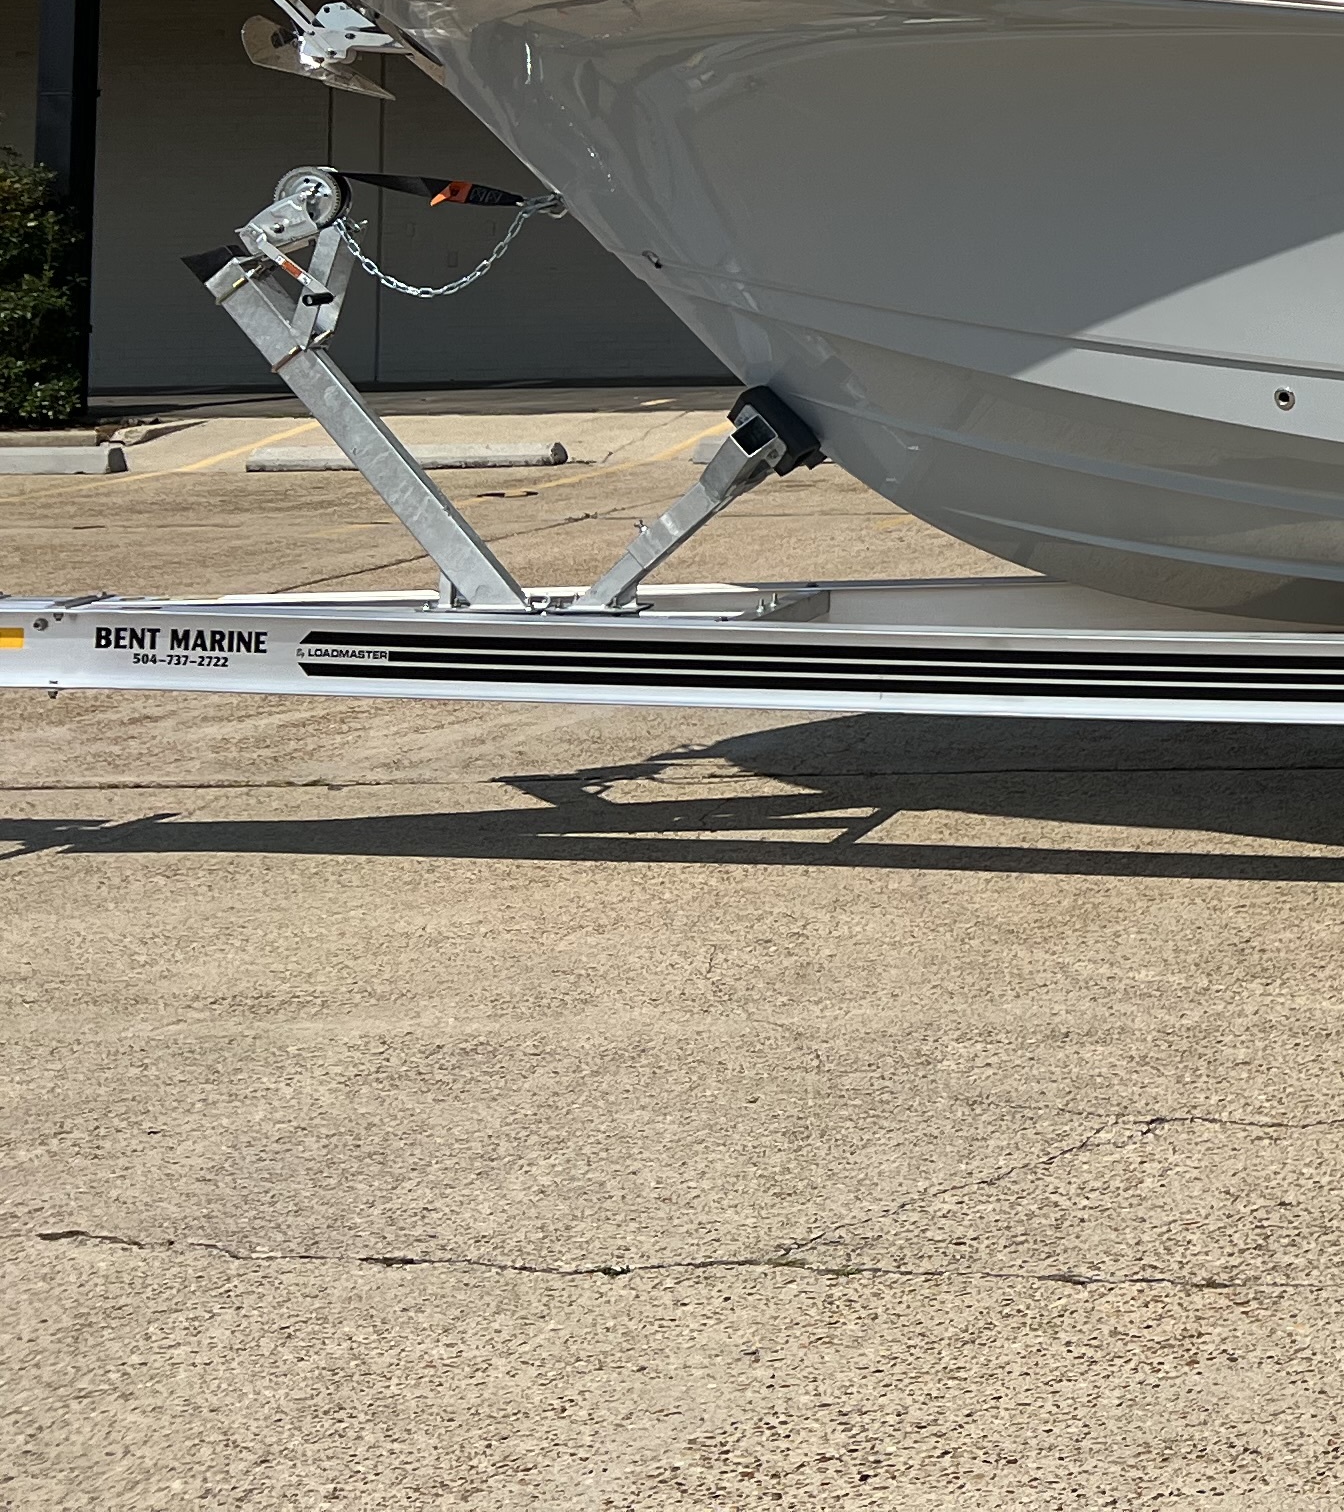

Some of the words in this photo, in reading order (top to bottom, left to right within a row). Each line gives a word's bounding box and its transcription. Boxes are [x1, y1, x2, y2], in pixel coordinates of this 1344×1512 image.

[94, 626, 161, 650] BENT
[169, 628, 268, 654] MARINE
[132, 653, 229, 668] 504-737-2722
[307, 647, 388, 660] LOADMASTER
